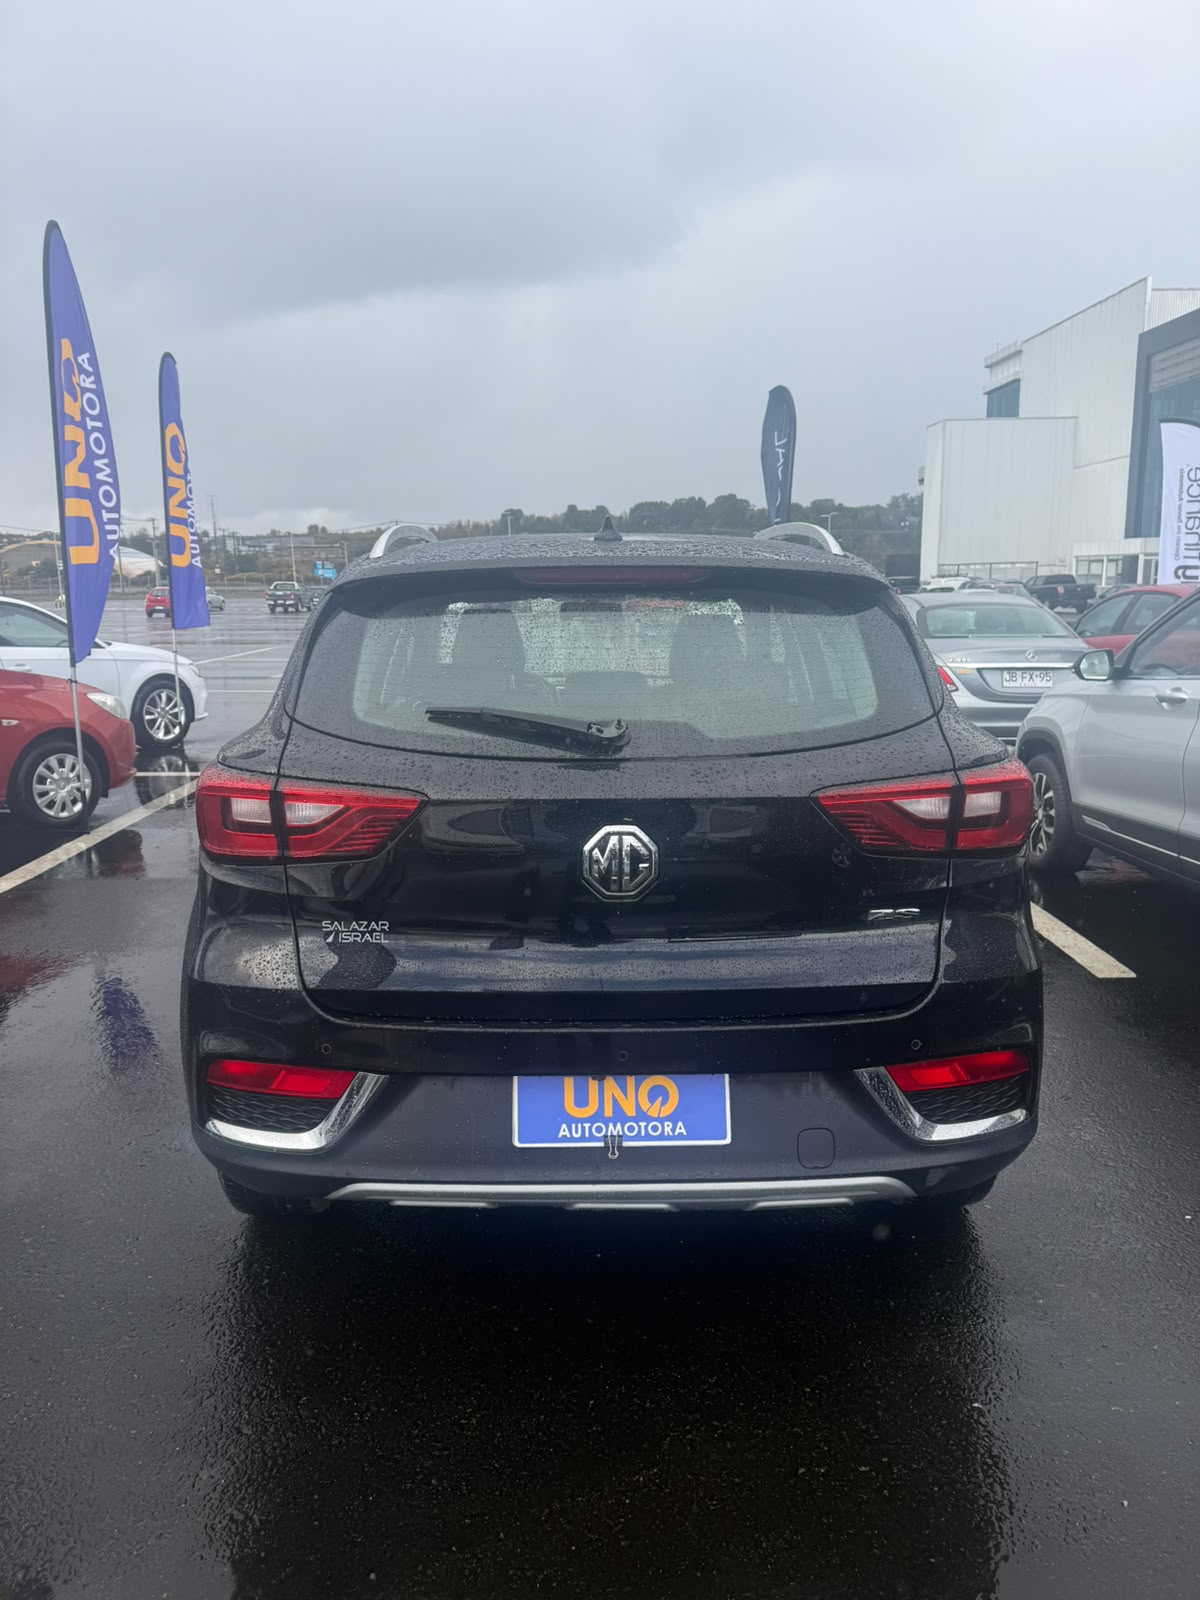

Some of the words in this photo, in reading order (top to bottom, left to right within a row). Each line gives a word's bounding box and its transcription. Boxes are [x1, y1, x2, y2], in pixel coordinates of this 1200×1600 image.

[61, 338, 99, 565] UNO
[77, 352, 119, 560] AUTOMOTORA
[165, 422, 191, 567] UNO
[186, 473, 203, 568] AUTOMOT
[592, 835, 650, 891] MG
[322, 920, 389, 931] SALAZAR
[339, 932, 389, 943] ISRAEL
[564, 1075, 679, 1118] UNO
[558, 1121, 687, 1138] AUTOMOTORA
